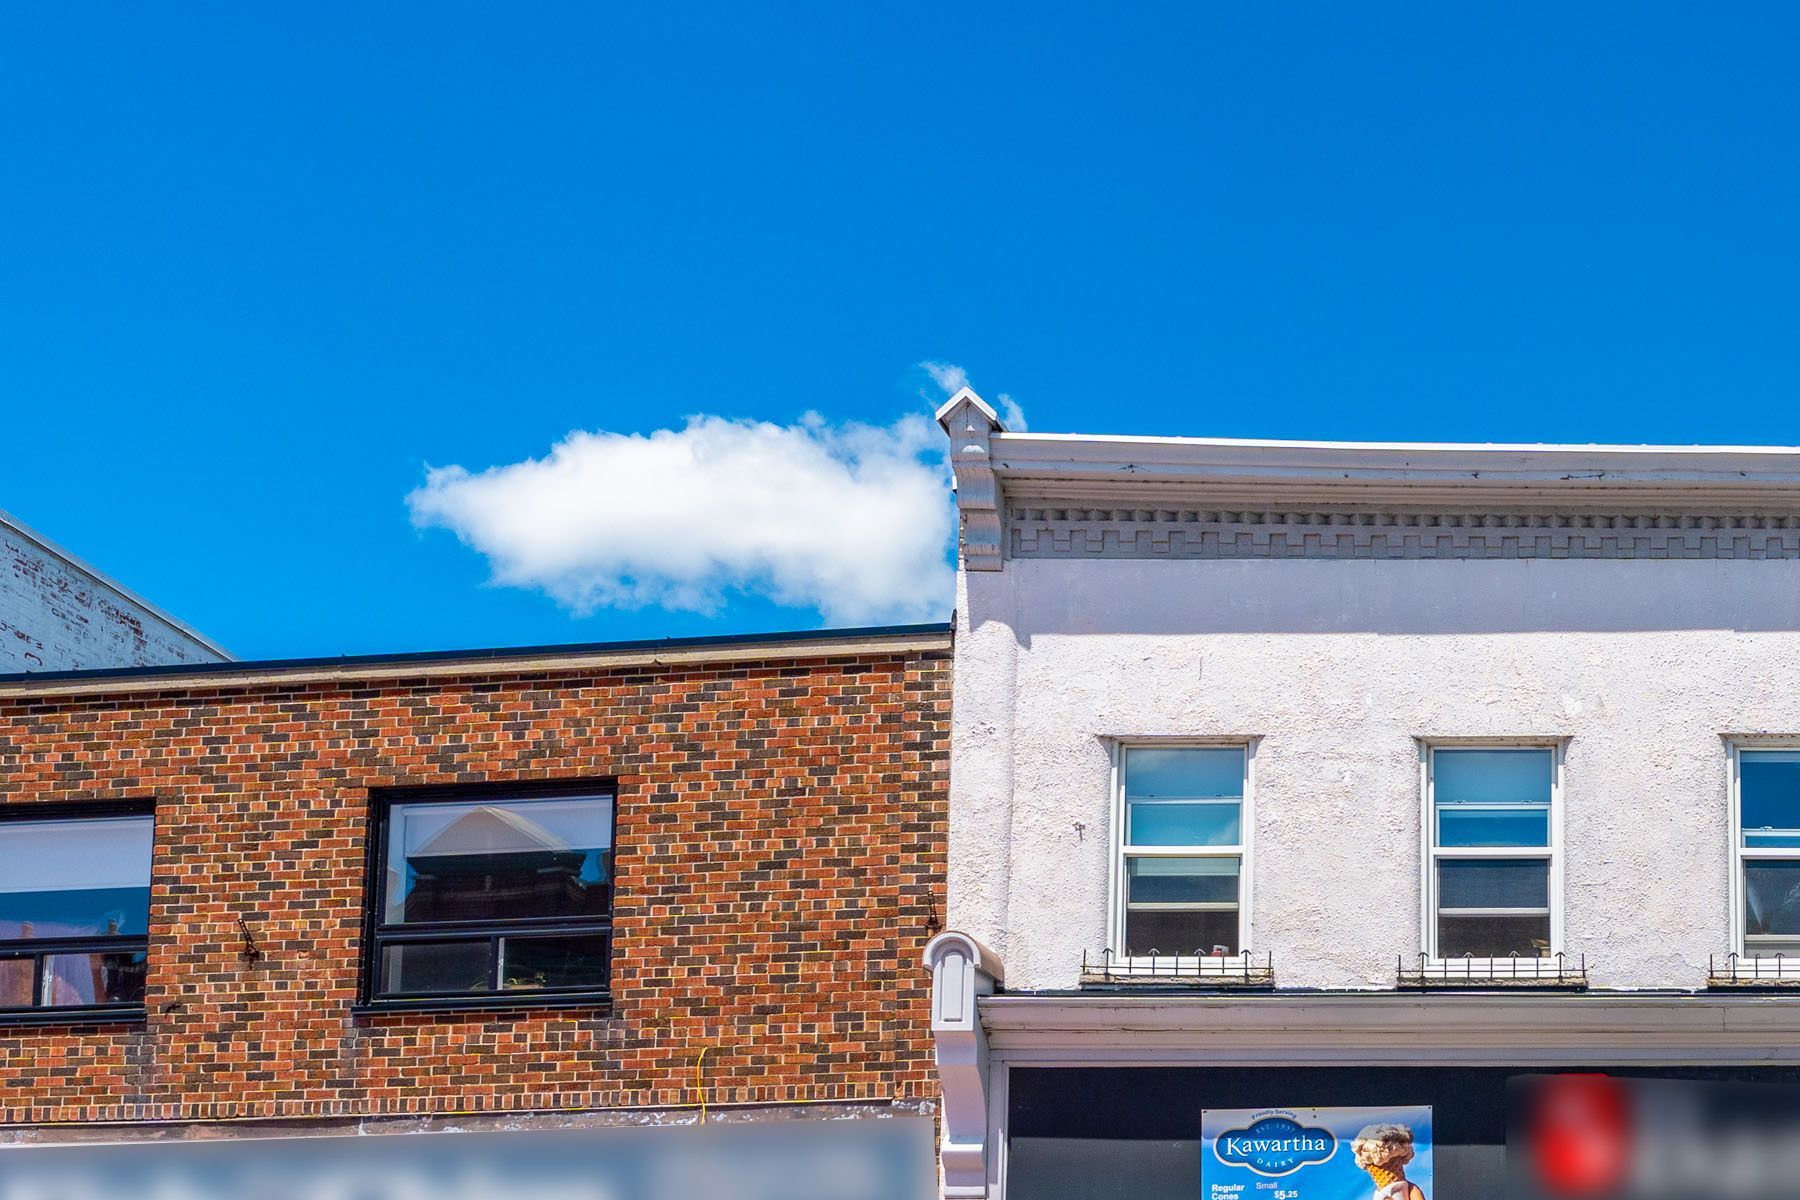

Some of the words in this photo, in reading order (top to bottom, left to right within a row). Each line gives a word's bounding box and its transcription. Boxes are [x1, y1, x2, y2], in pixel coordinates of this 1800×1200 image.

[1251, 1109, 1274, 1120] Proudly
[1275, 1109, 1297, 1119] Serving
[1226, 1134, 1325, 1157] Kawartha
[1257, 1157, 1294, 1168] DAIRY
[1211, 1184, 1245, 1193] Regular
[1211, 1193, 1239, 1200] Cones
[1274, 1190, 1298, 1200] $5.25
